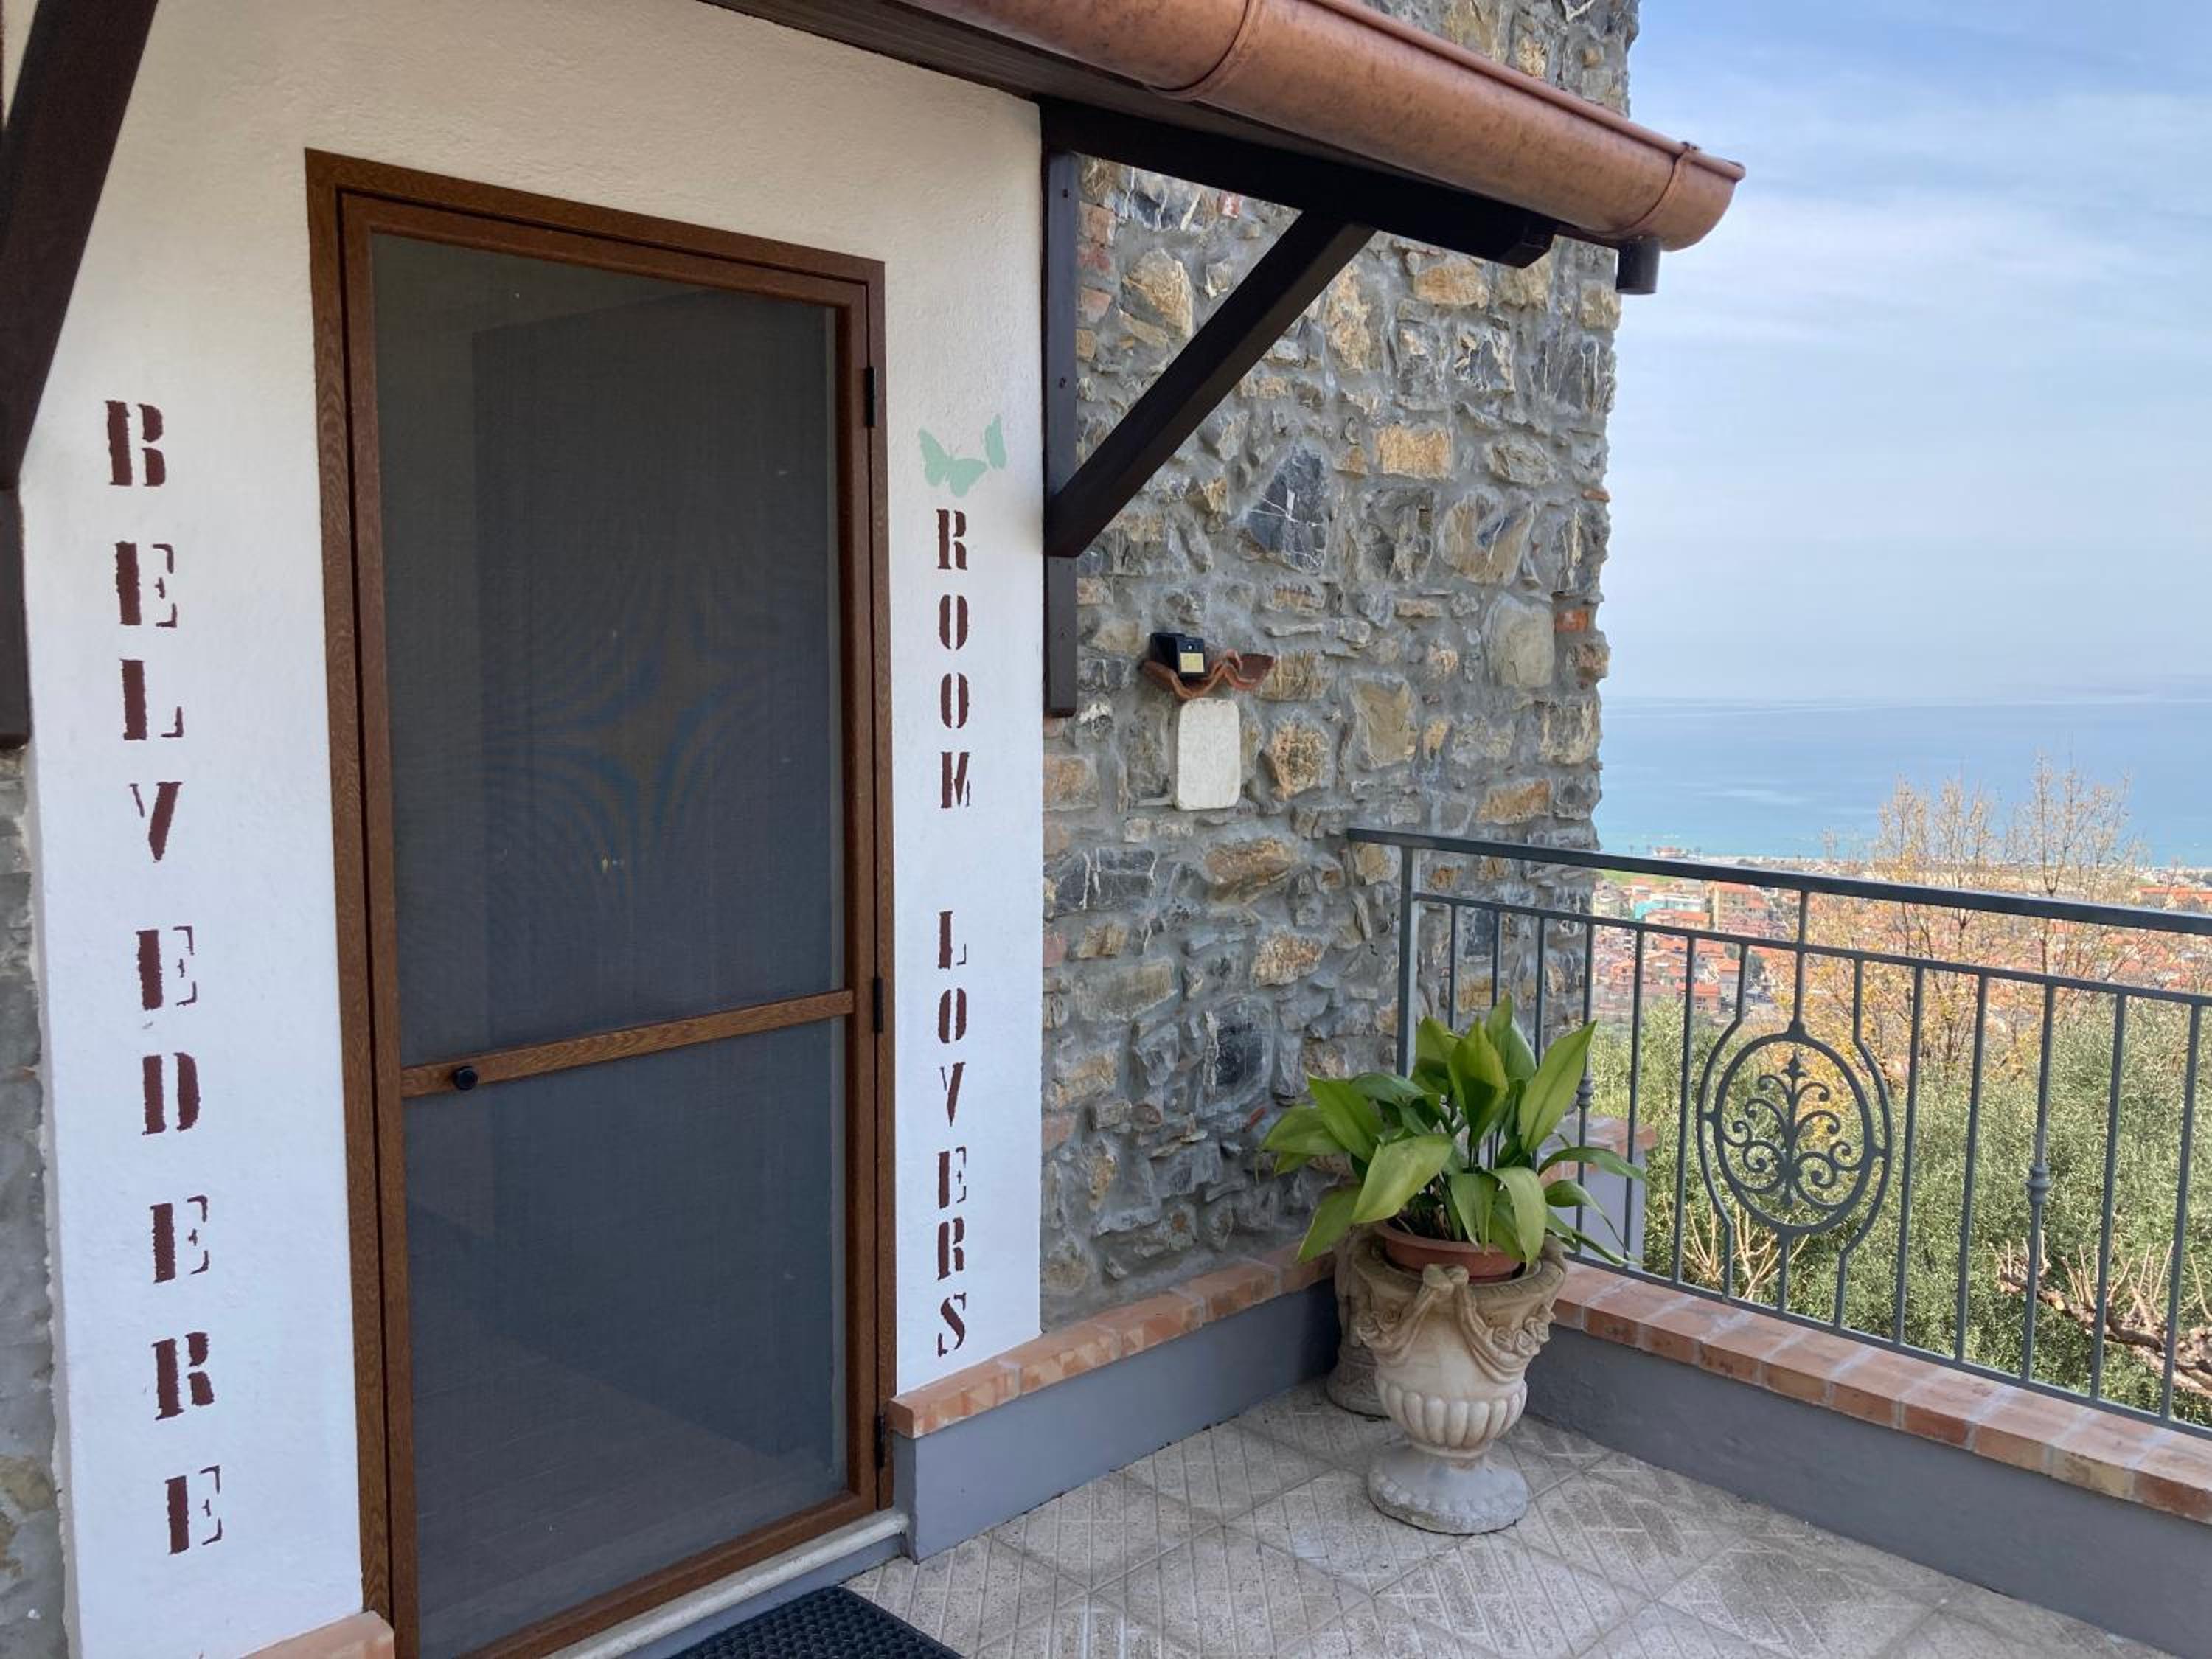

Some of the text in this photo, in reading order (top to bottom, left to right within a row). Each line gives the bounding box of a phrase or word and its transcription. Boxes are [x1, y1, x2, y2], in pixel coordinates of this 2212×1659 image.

[105, 399, 223, 1557] BELVEDERE
[935, 508, 972, 1358] ROOM LOVERS
